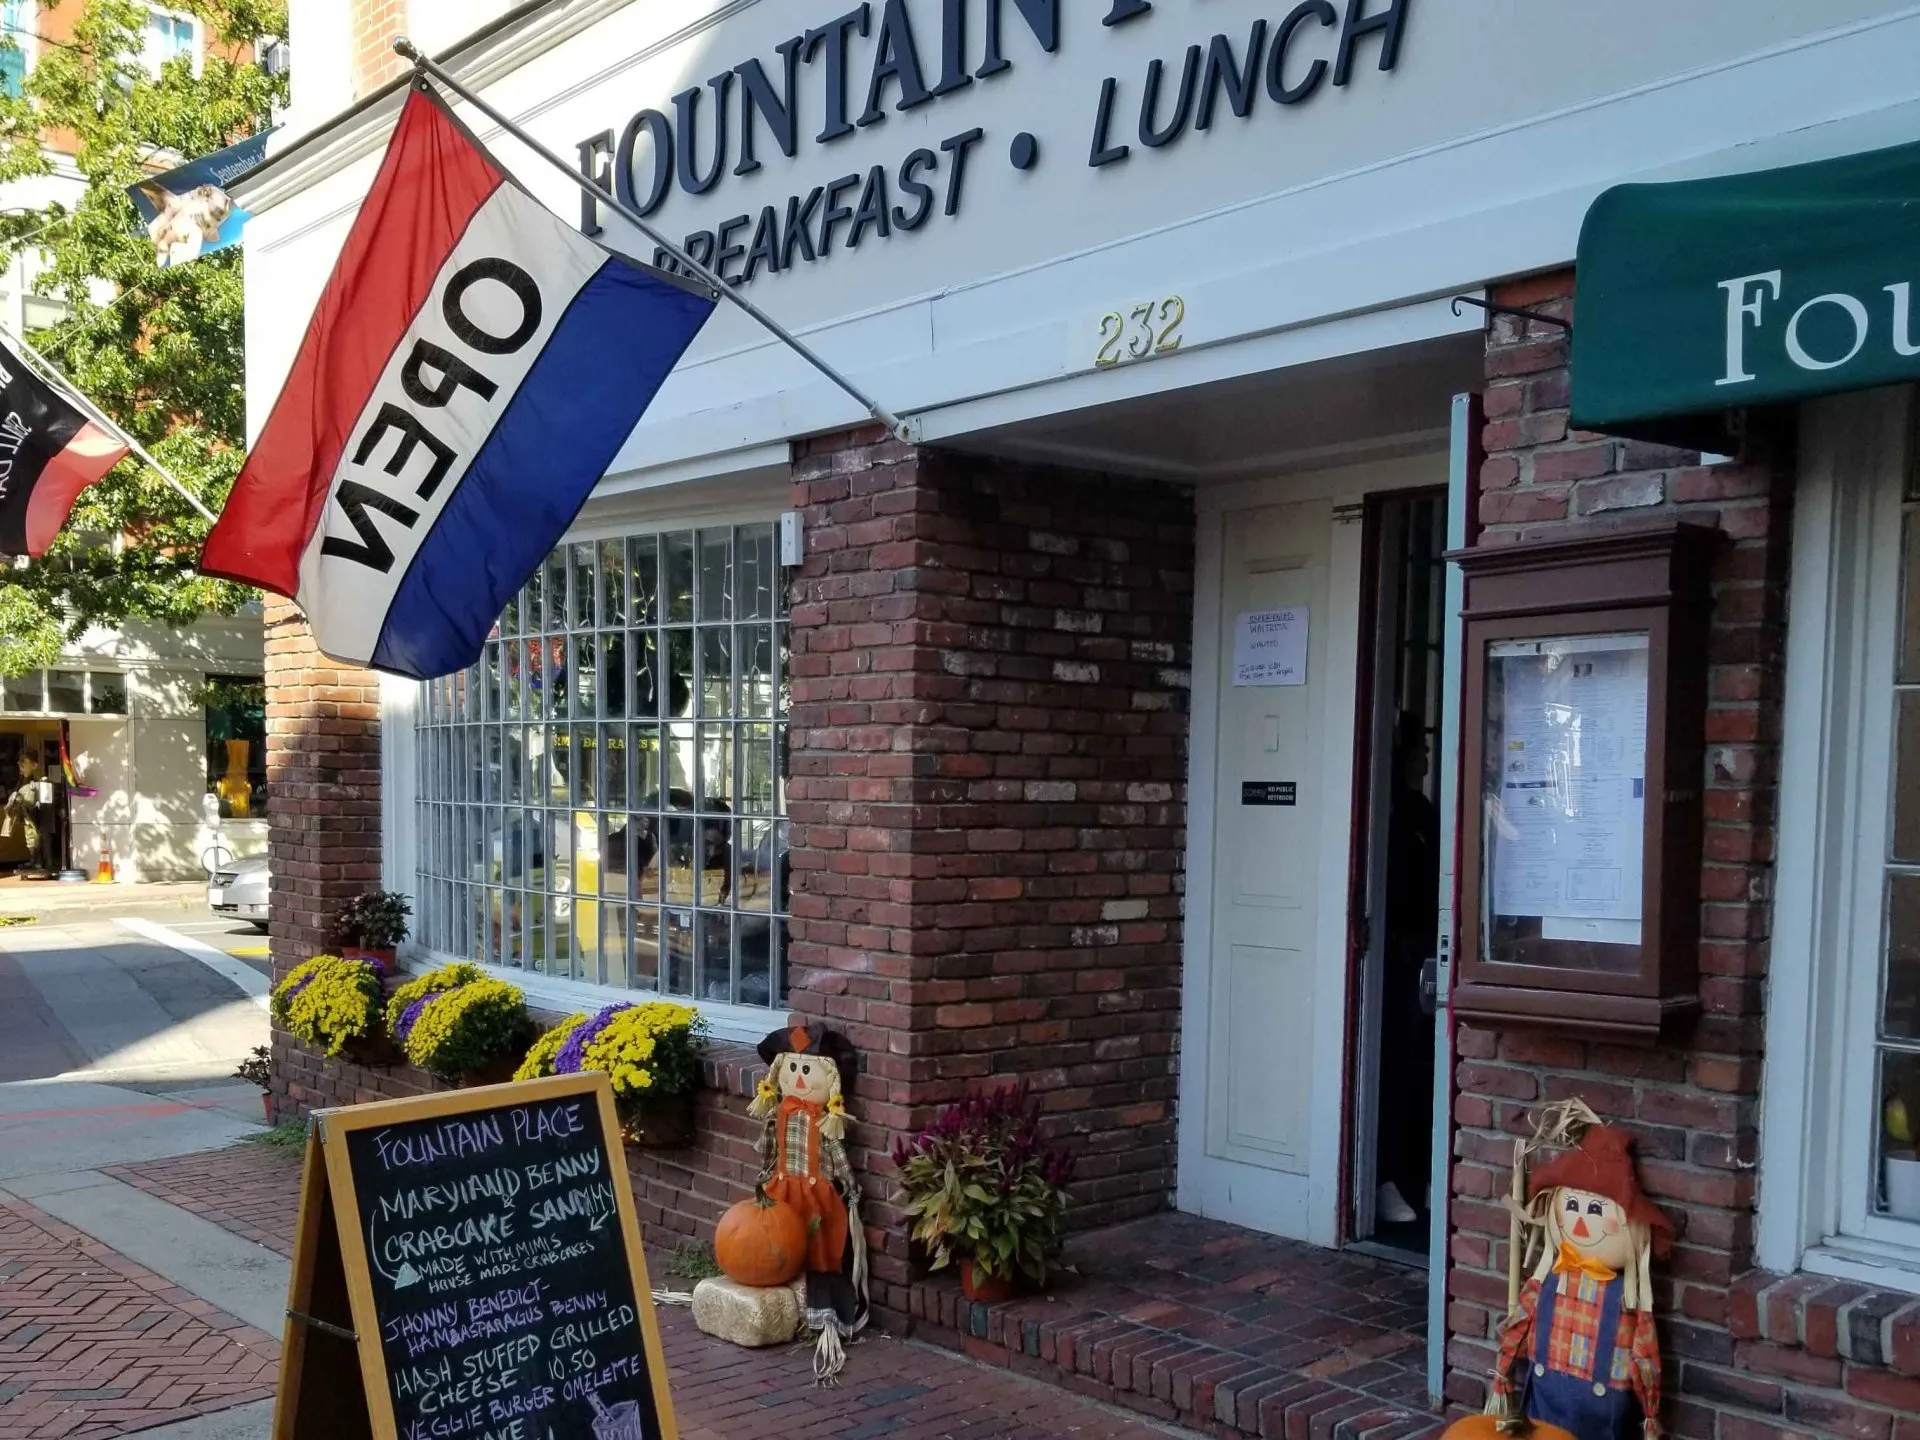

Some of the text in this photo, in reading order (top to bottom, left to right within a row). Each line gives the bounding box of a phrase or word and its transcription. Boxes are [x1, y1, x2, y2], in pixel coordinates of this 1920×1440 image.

[1089, 0, 1409, 168] LUNCH
[575, 0, 1059, 236] FOUNTAIN
[1095, 295, 1185, 367] 232
[1250, 622, 1287, 633] WAITRESS
[1250, 640, 1278, 649] WANTED
[583, 737, 648, 750] BARAS
[373, 1104, 584, 1170] FOUNTAIN PLACE
[524, 1146, 600, 1190] BENNY
[502, 1194, 516, 1209] &
[385, 1213, 516, 1263] CRABCAKE
[418, 1233, 563, 1280] MADE WITH MIMIS
[428, 1272, 476, 1294] HOUSE
[523, 1239, 595, 1270] CRABCAKES
[386, 1301, 458, 1343] JHONNY
[549, 1288, 608, 1317] BENNY
[395, 1304, 634, 1399] HASH STUFFED GRILLED
[403, 1407, 484, 1440] VEGGIE
[489, 1385, 555, 1423] BURGER
[562, 1353, 642, 1402] OMELETTE
[419, 1348, 596, 1414] CHEESE 10.50
